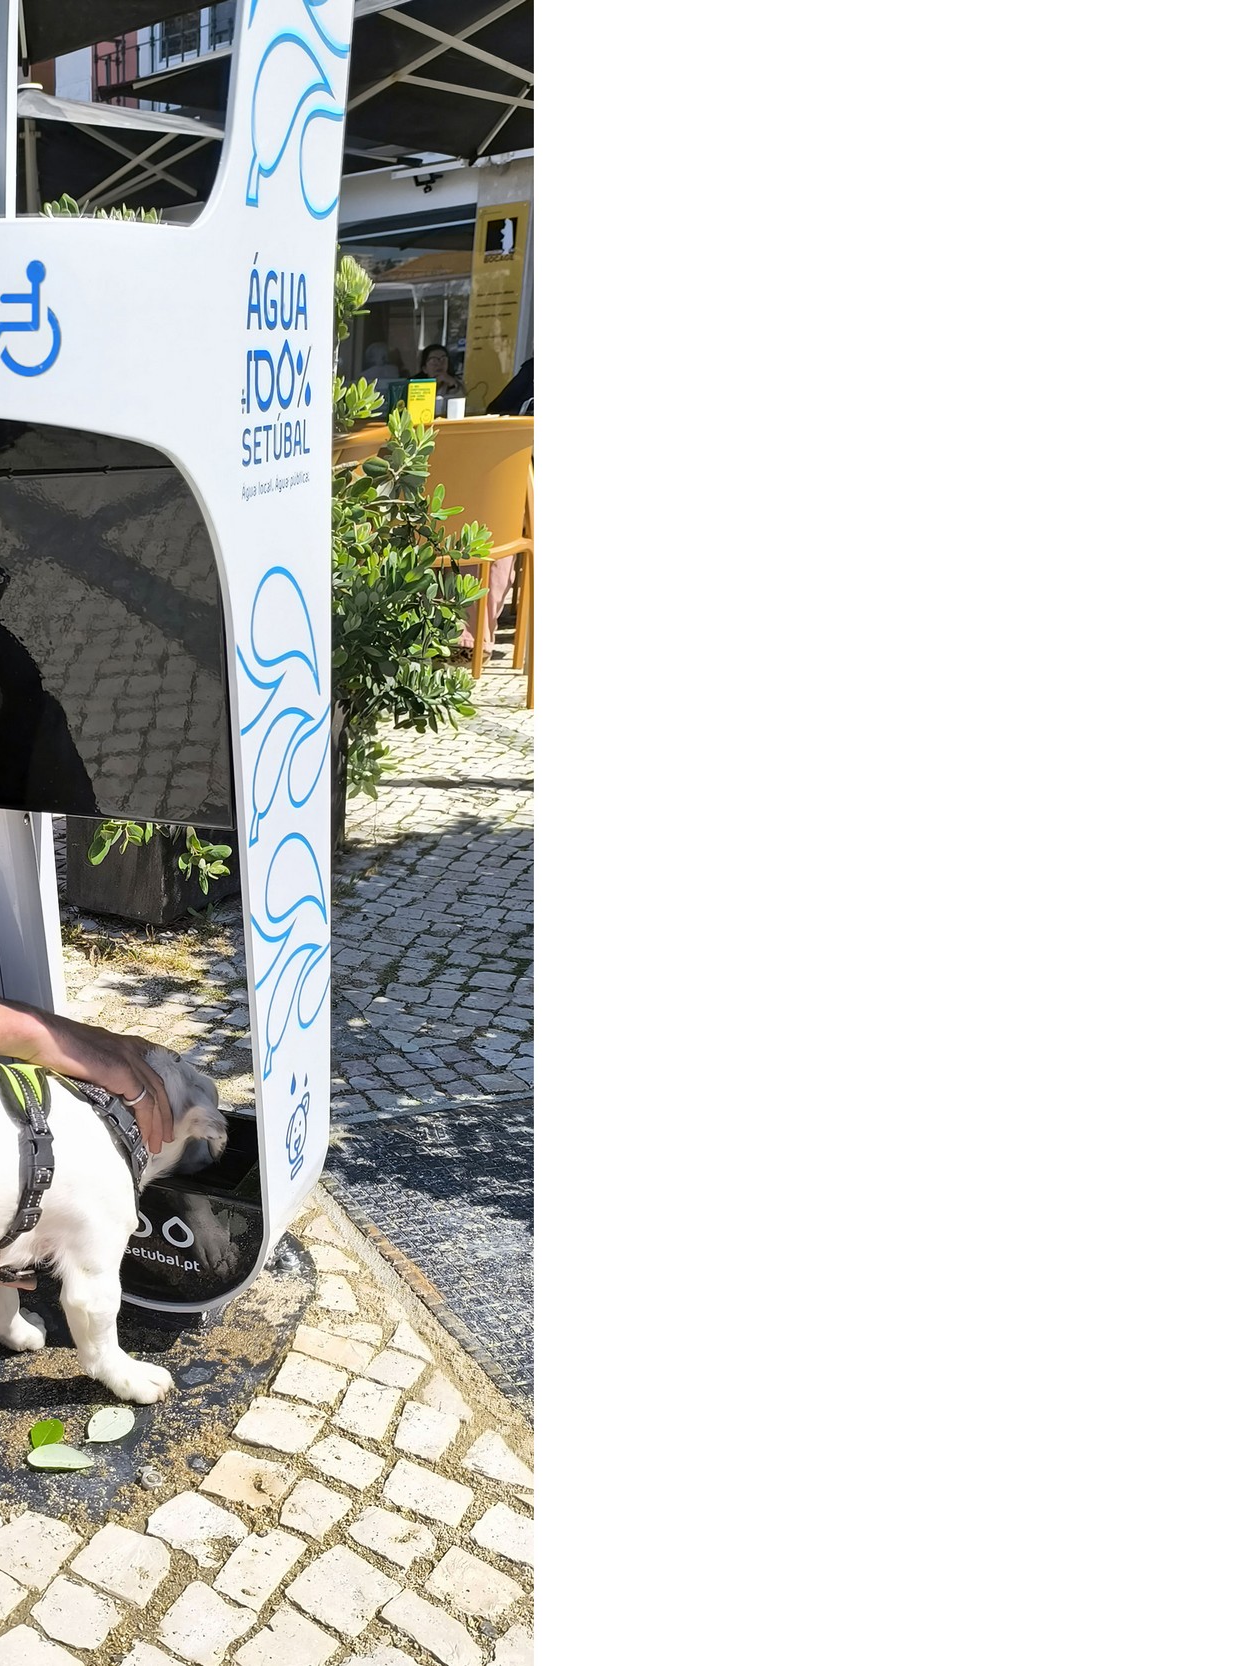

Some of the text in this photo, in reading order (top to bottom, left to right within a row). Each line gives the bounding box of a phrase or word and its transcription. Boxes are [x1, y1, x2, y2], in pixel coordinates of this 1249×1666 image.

[247, 252, 307, 330] ÁGUA
[247, 339, 312, 413] 100%
[242, 413, 310, 467] SETÚBAL
[242, 482, 257, 501] Água
[275, 474, 289, 492] Água
